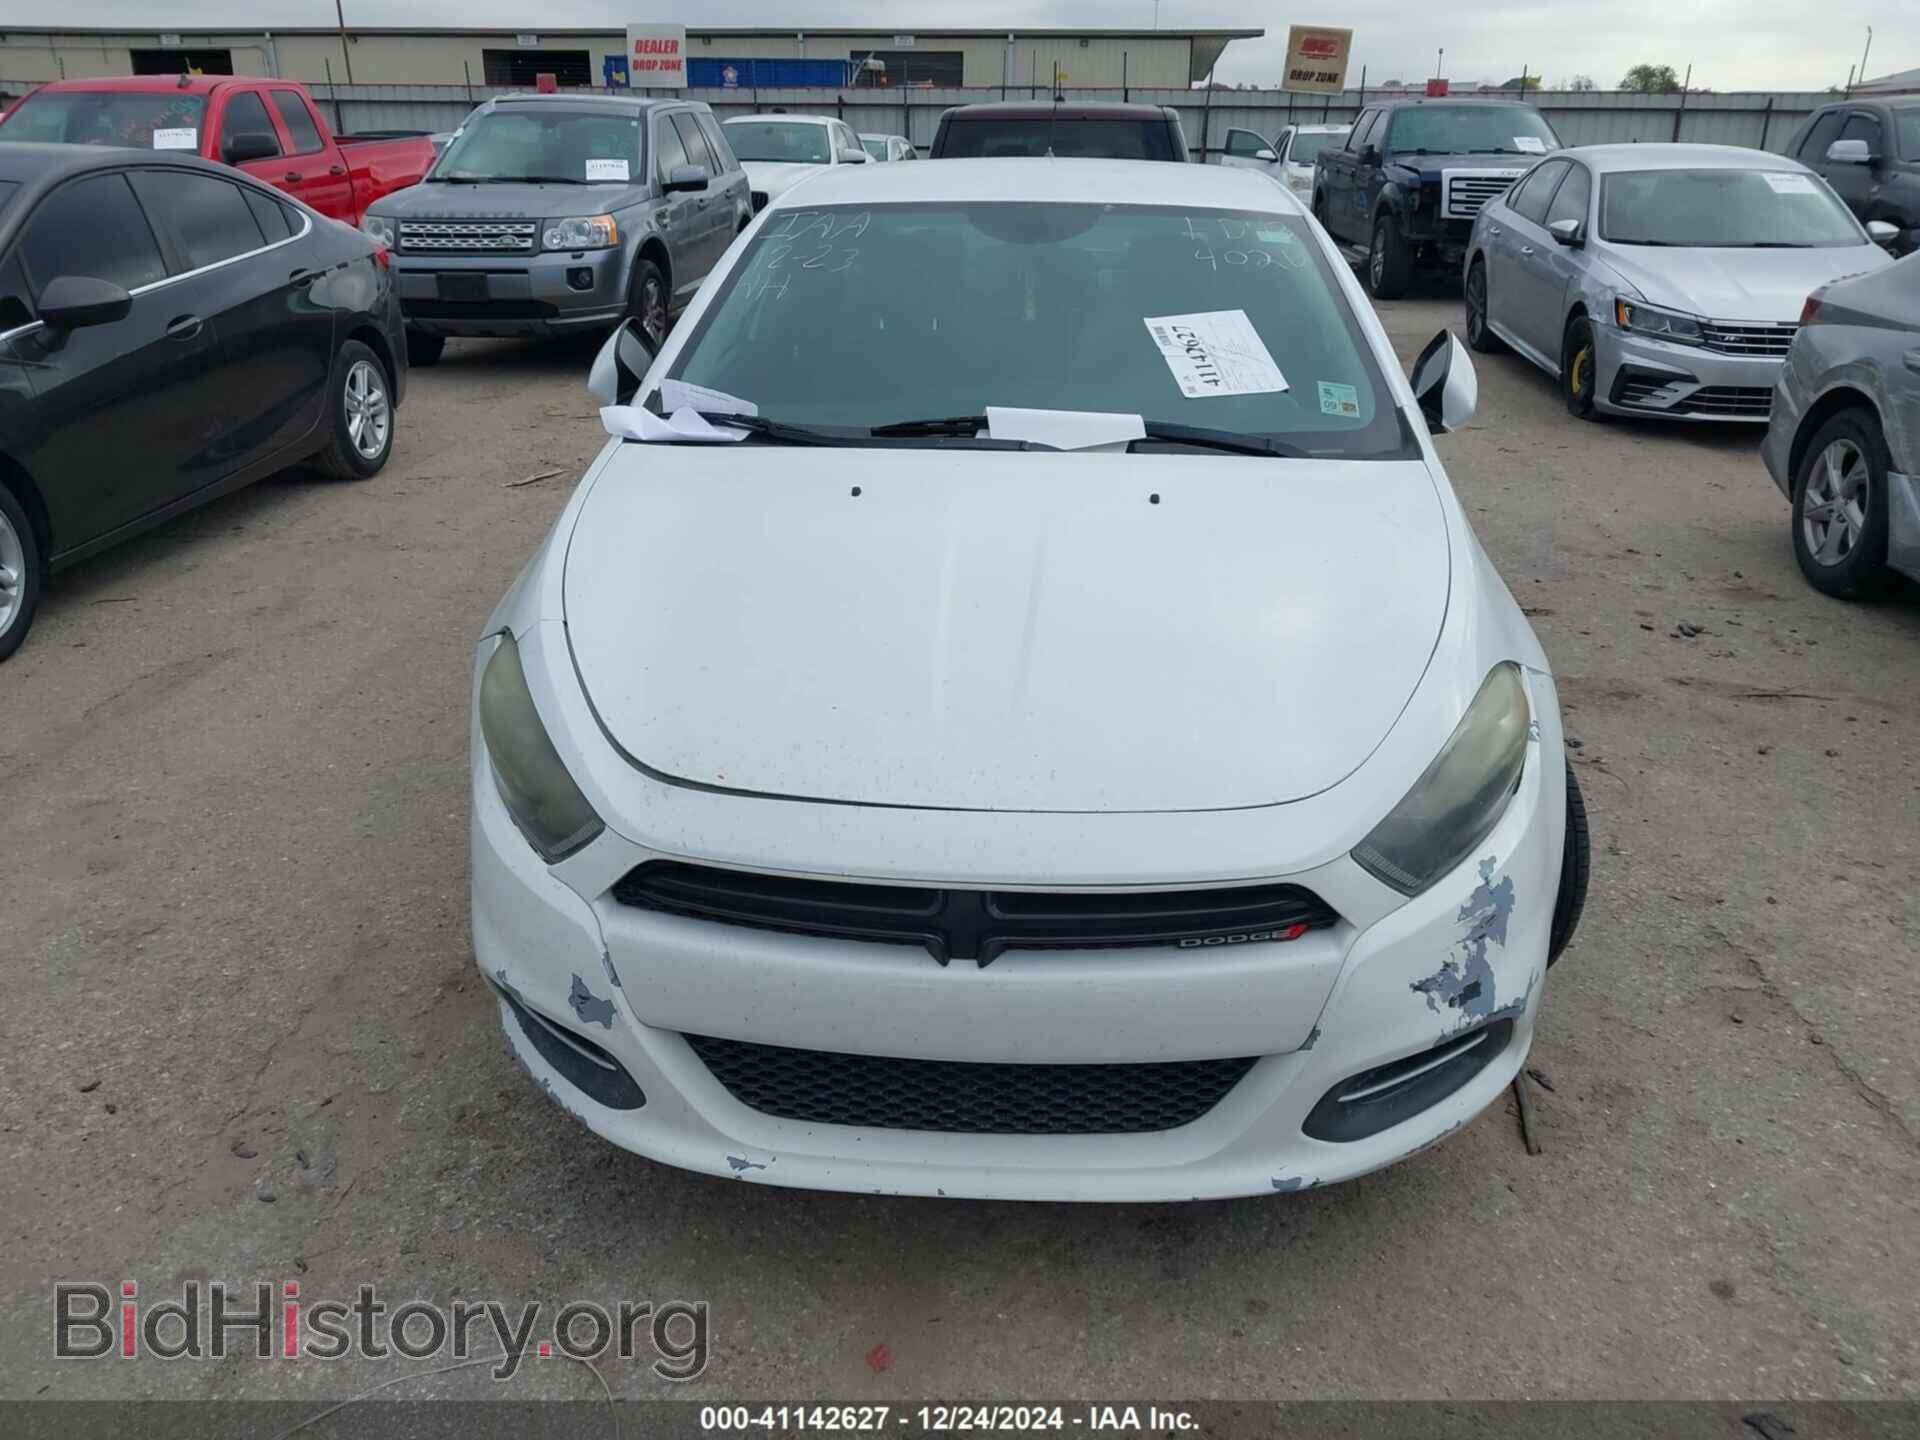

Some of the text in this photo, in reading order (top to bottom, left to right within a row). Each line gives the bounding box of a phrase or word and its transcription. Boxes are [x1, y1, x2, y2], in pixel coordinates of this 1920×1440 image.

[635, 39, 679, 54] DEALER
[632, 59, 682, 72] DROP ZONE
[1289, 70, 1339, 84] DROP ZONE
[1179, 929, 1290, 948] DODGE
